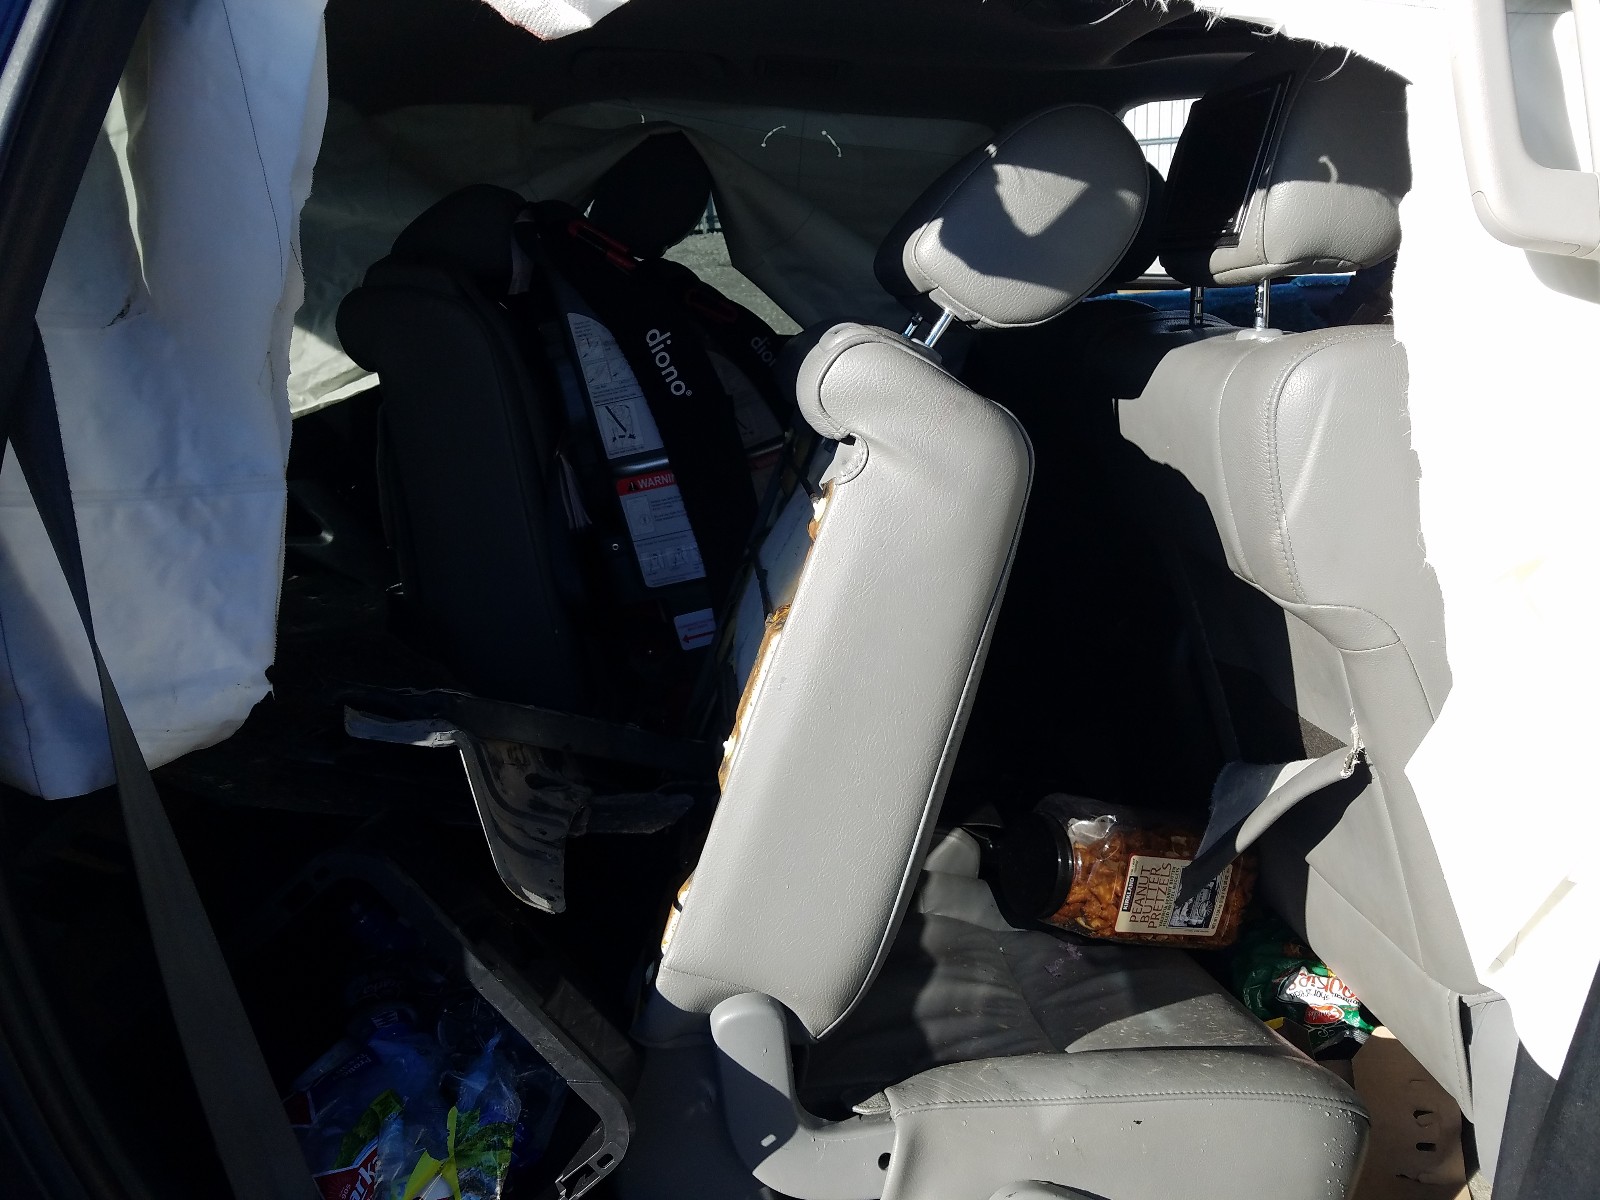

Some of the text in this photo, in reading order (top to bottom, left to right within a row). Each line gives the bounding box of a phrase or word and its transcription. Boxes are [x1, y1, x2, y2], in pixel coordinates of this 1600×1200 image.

[1122, 877, 1135, 911] KIRKLAND
[1129, 865, 1150, 923] PEANUT
[1140, 867, 1161, 923] BUTTER
[1147, 862, 1172, 929] PRETZELS
